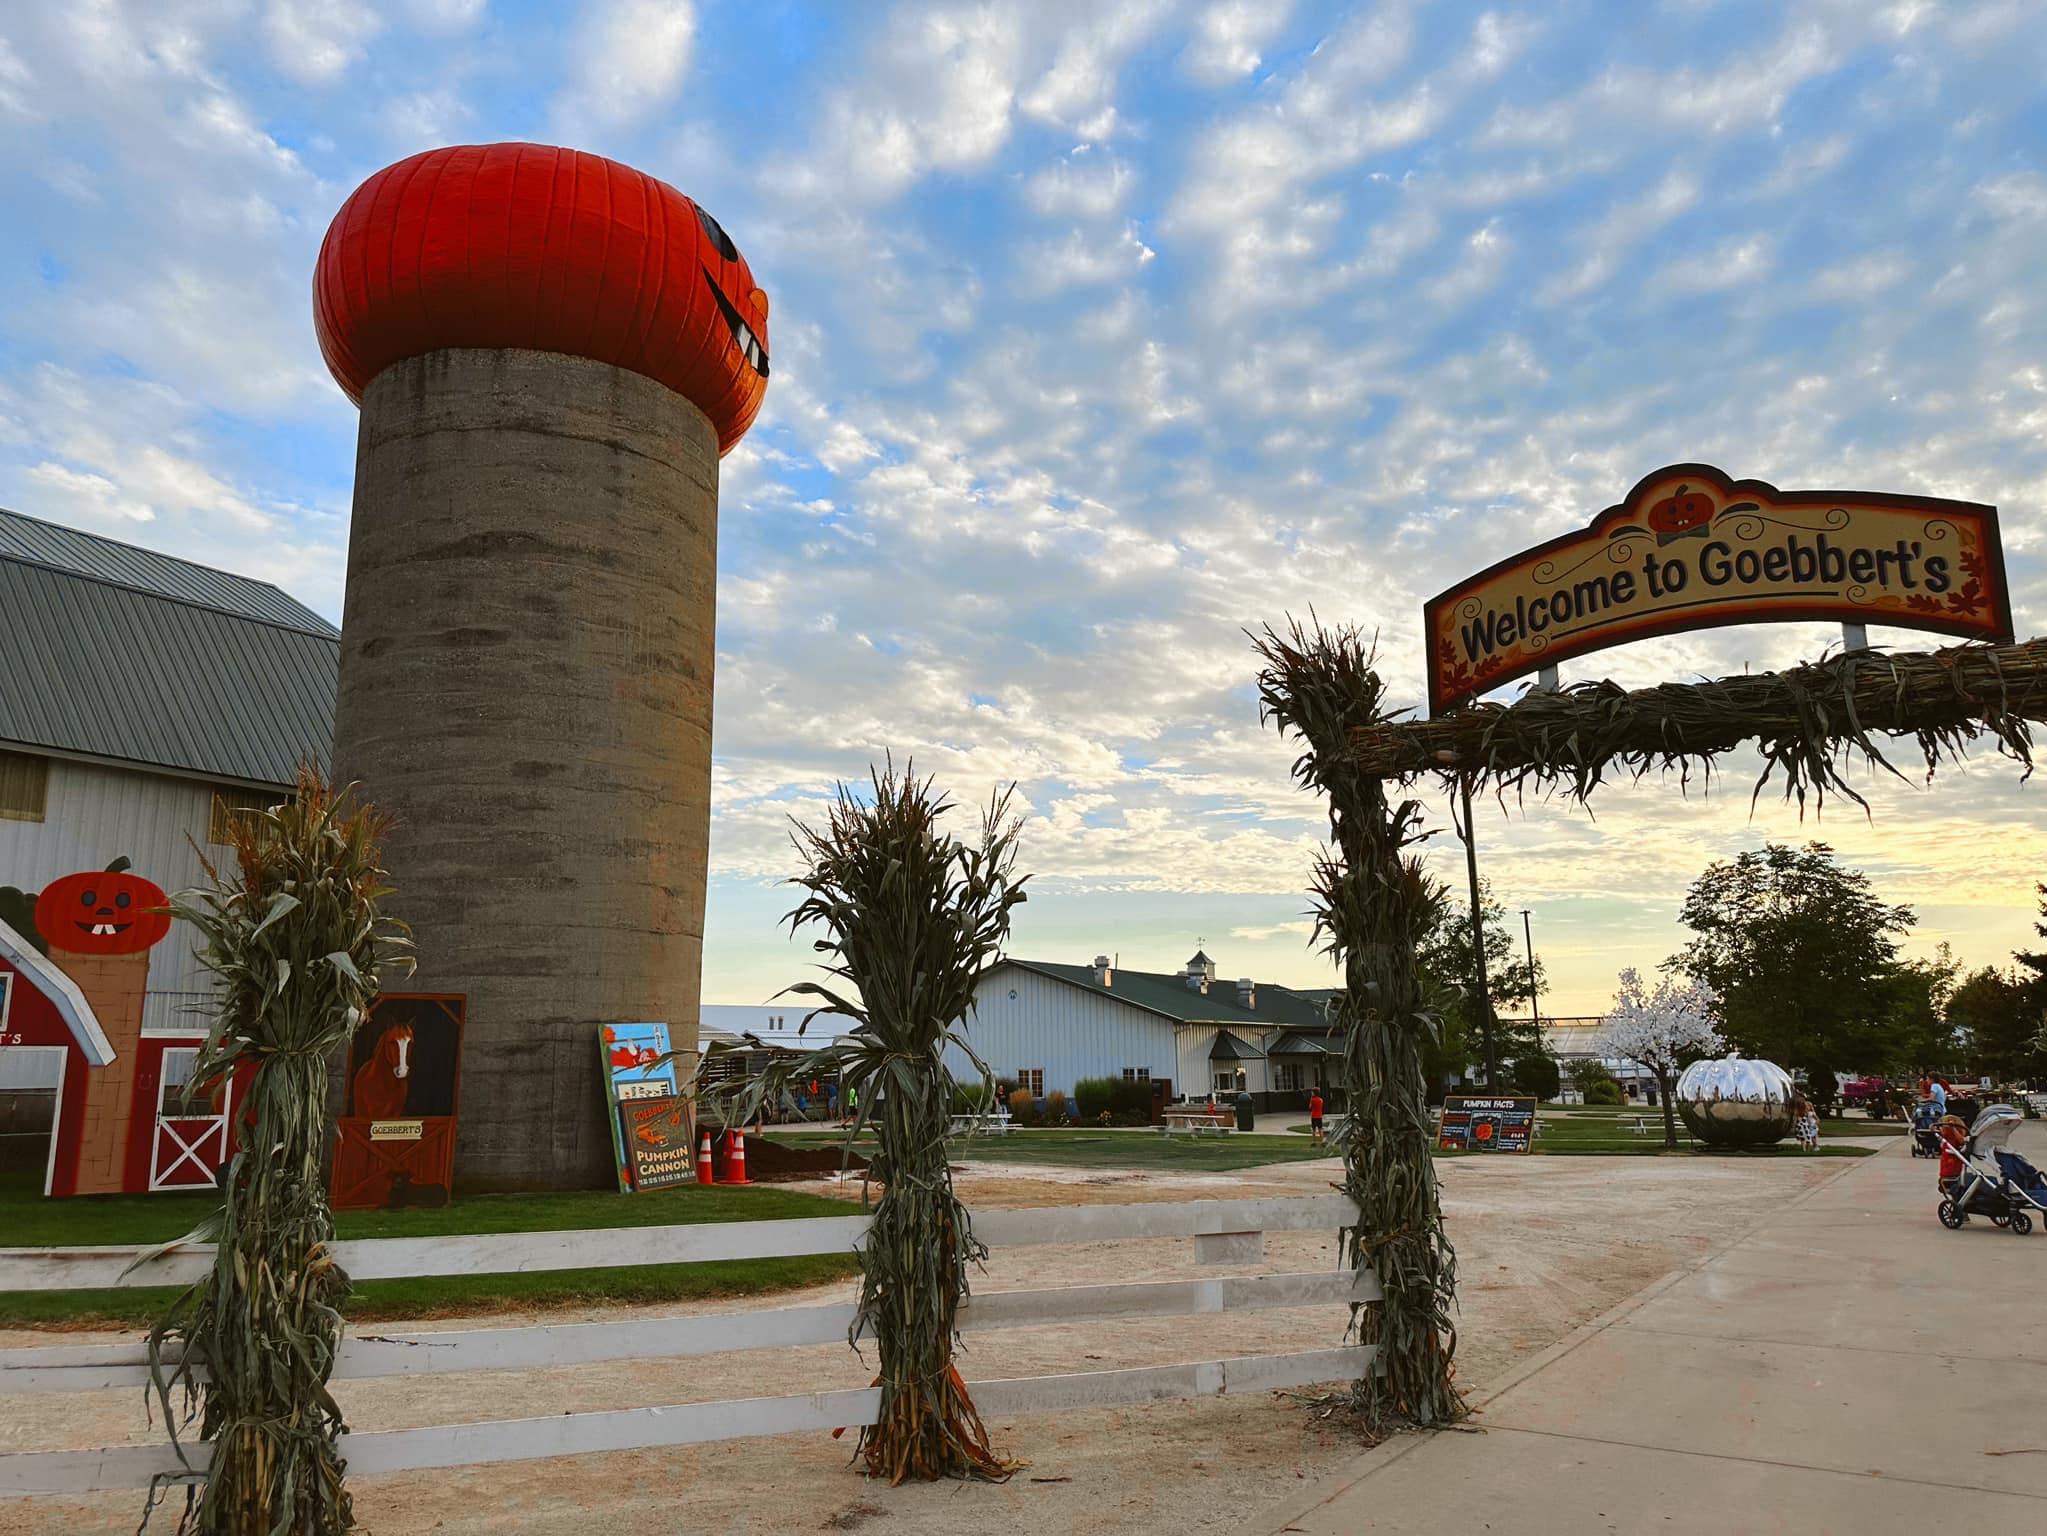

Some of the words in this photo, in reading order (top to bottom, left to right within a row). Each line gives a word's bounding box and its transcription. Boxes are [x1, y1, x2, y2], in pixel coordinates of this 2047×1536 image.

[1461, 570, 1636, 662] Welcome
[1643, 553, 1687, 598] to
[1699, 533, 1951, 593] Goebbert's
[1463, 1100, 1491, 1109] PUMPKIN
[1493, 1100, 1515, 1109] FACTS
[637, 1145, 689, 1162] PUMPKIN
[640, 1158, 690, 1175] CANNON
